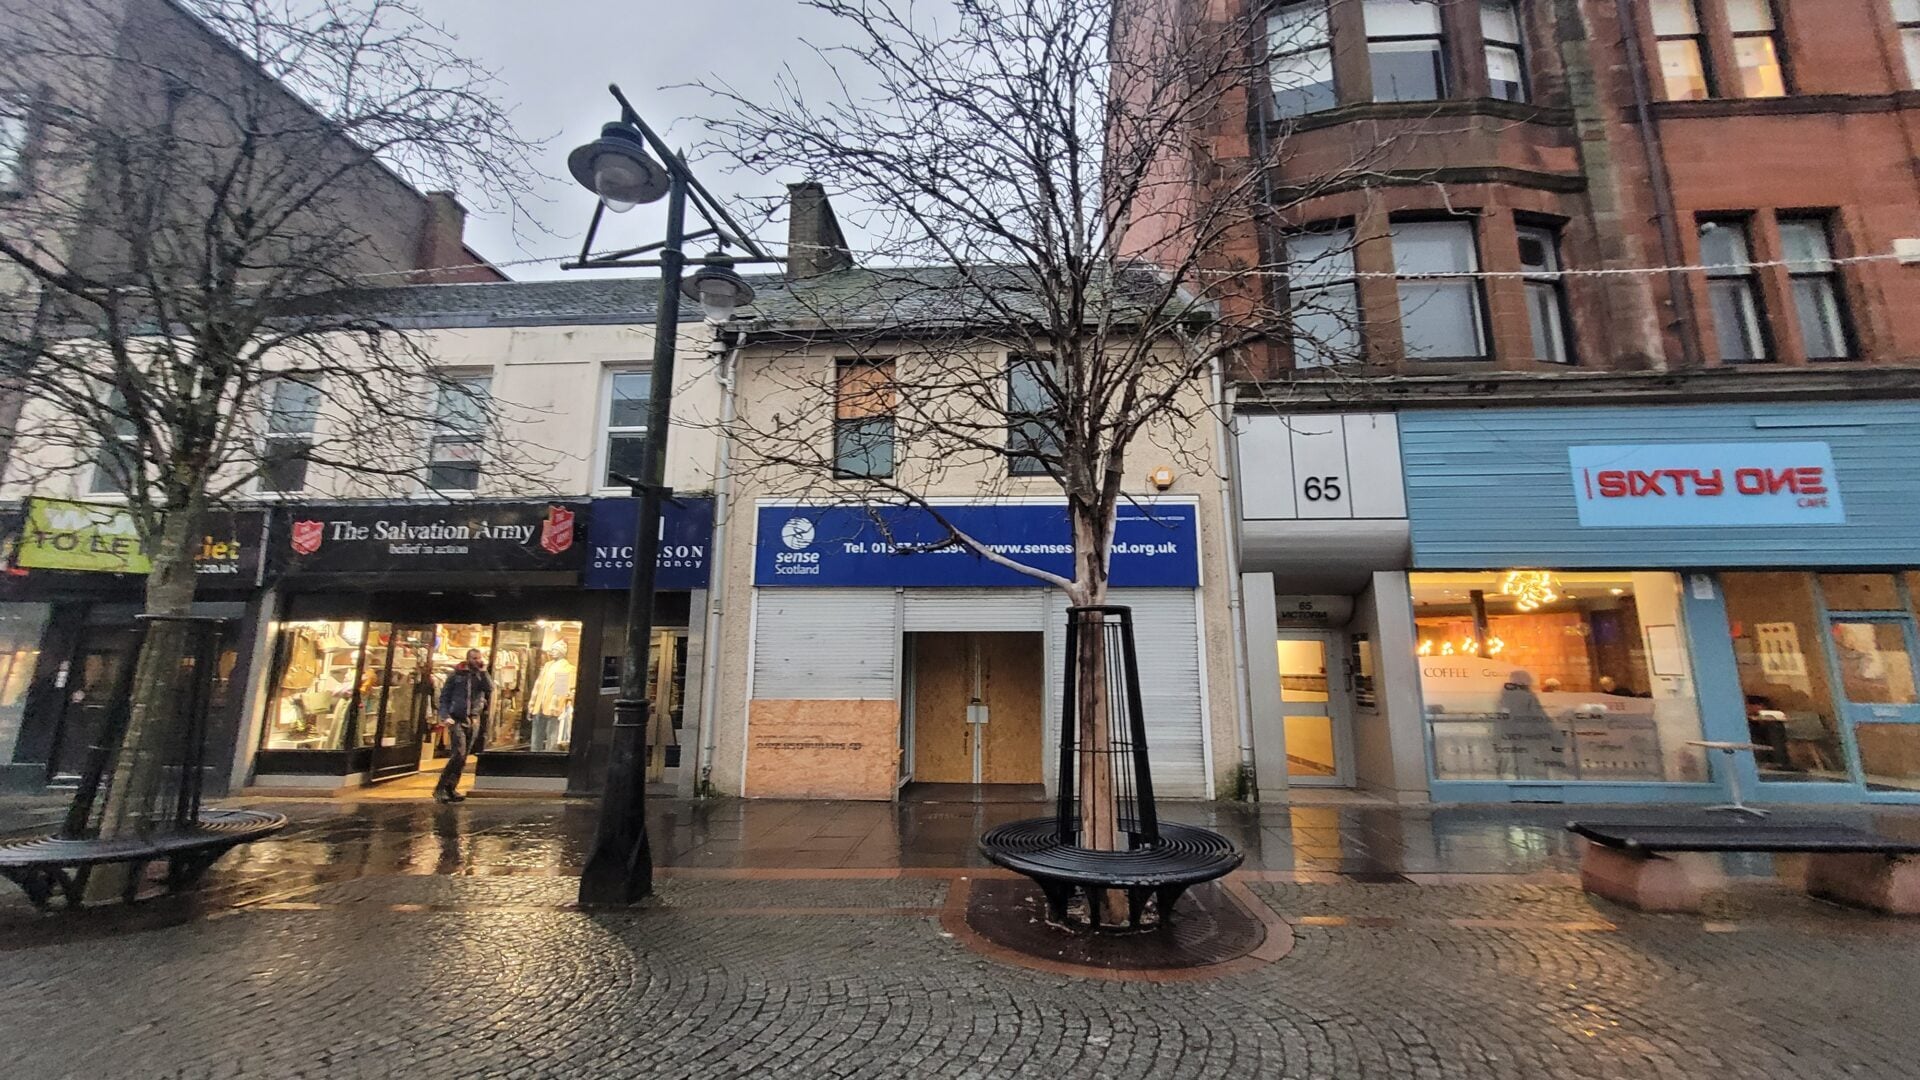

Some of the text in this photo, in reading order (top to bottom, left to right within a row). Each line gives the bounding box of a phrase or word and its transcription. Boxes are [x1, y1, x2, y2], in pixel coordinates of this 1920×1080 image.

[1304, 476, 1341, 501] 65
[1597, 466, 1828, 497] SIXTY ONE
[330, 520, 370, 541] The
[373, 519, 470, 541] Salvation
[472, 520, 535, 545] Army
[34, 530, 79, 551] TO
[595, 545, 704, 559] NICSON
[843, 542, 868, 554] Tel.
[775, 551, 820, 564] sense
[774, 563, 820, 575] Scotland
[1423, 667, 1471, 679] COFFEE
